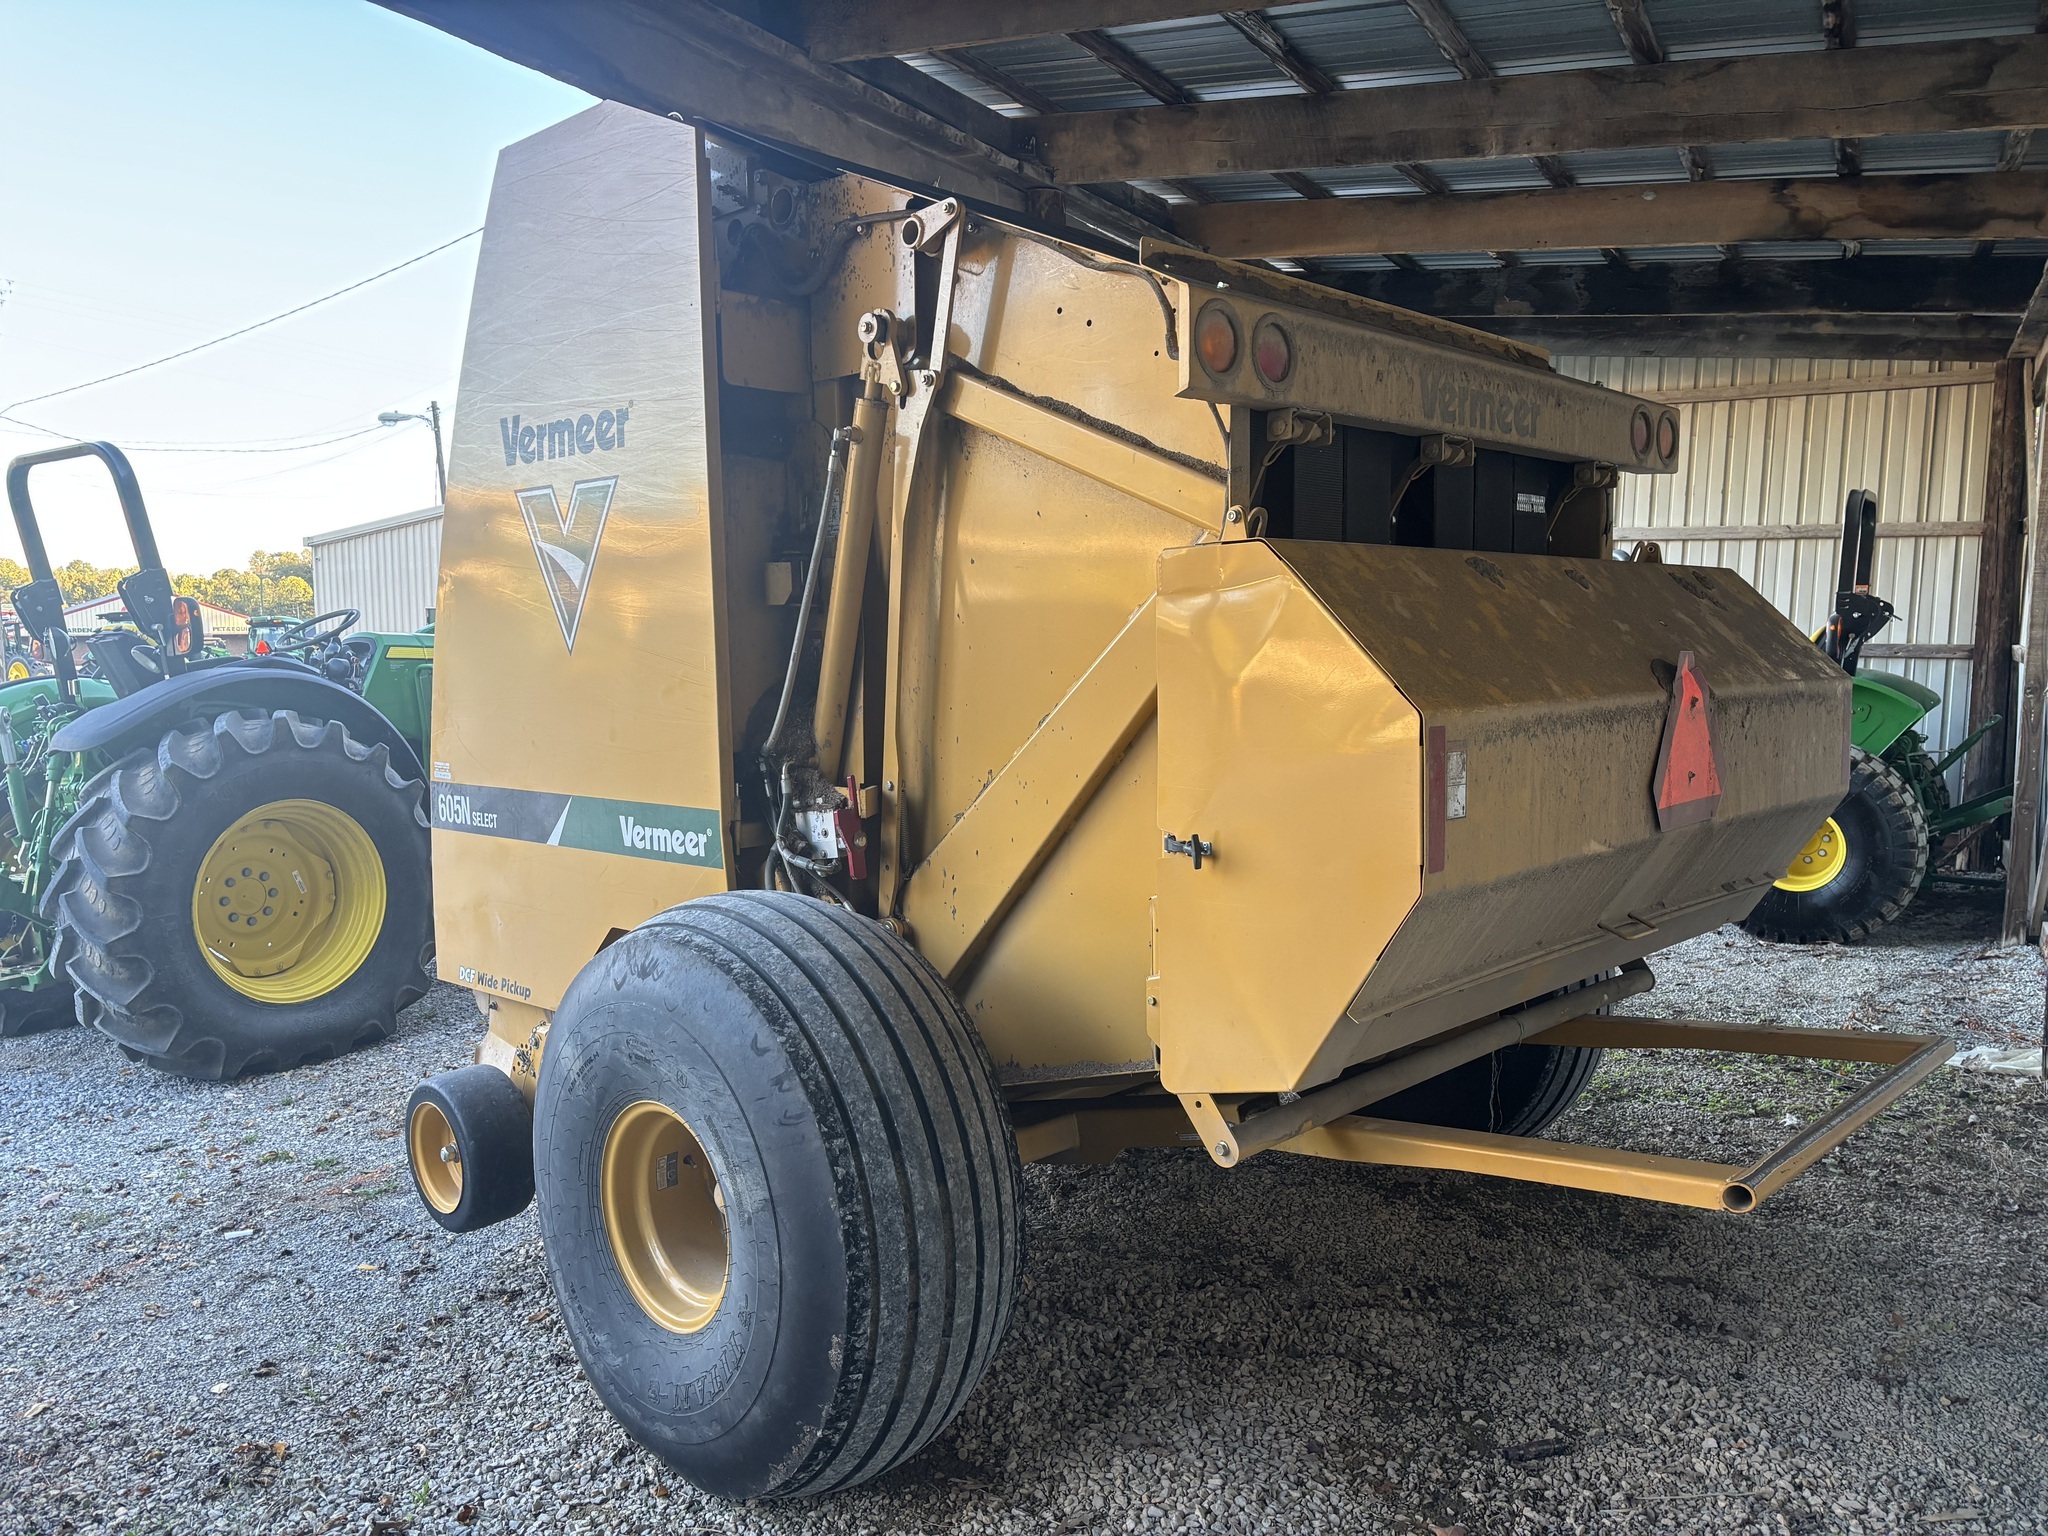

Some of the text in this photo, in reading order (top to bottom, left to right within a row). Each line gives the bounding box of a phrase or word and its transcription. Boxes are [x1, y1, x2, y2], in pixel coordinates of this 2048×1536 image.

[1420, 363, 1541, 439] Vermeer
[500, 407, 630, 467] Vermeer
[438, 793, 498, 829] 605N SELECT
[618, 815, 707, 857] Vermeer
[459, 965, 532, 1001] DCF Wide Pickup
